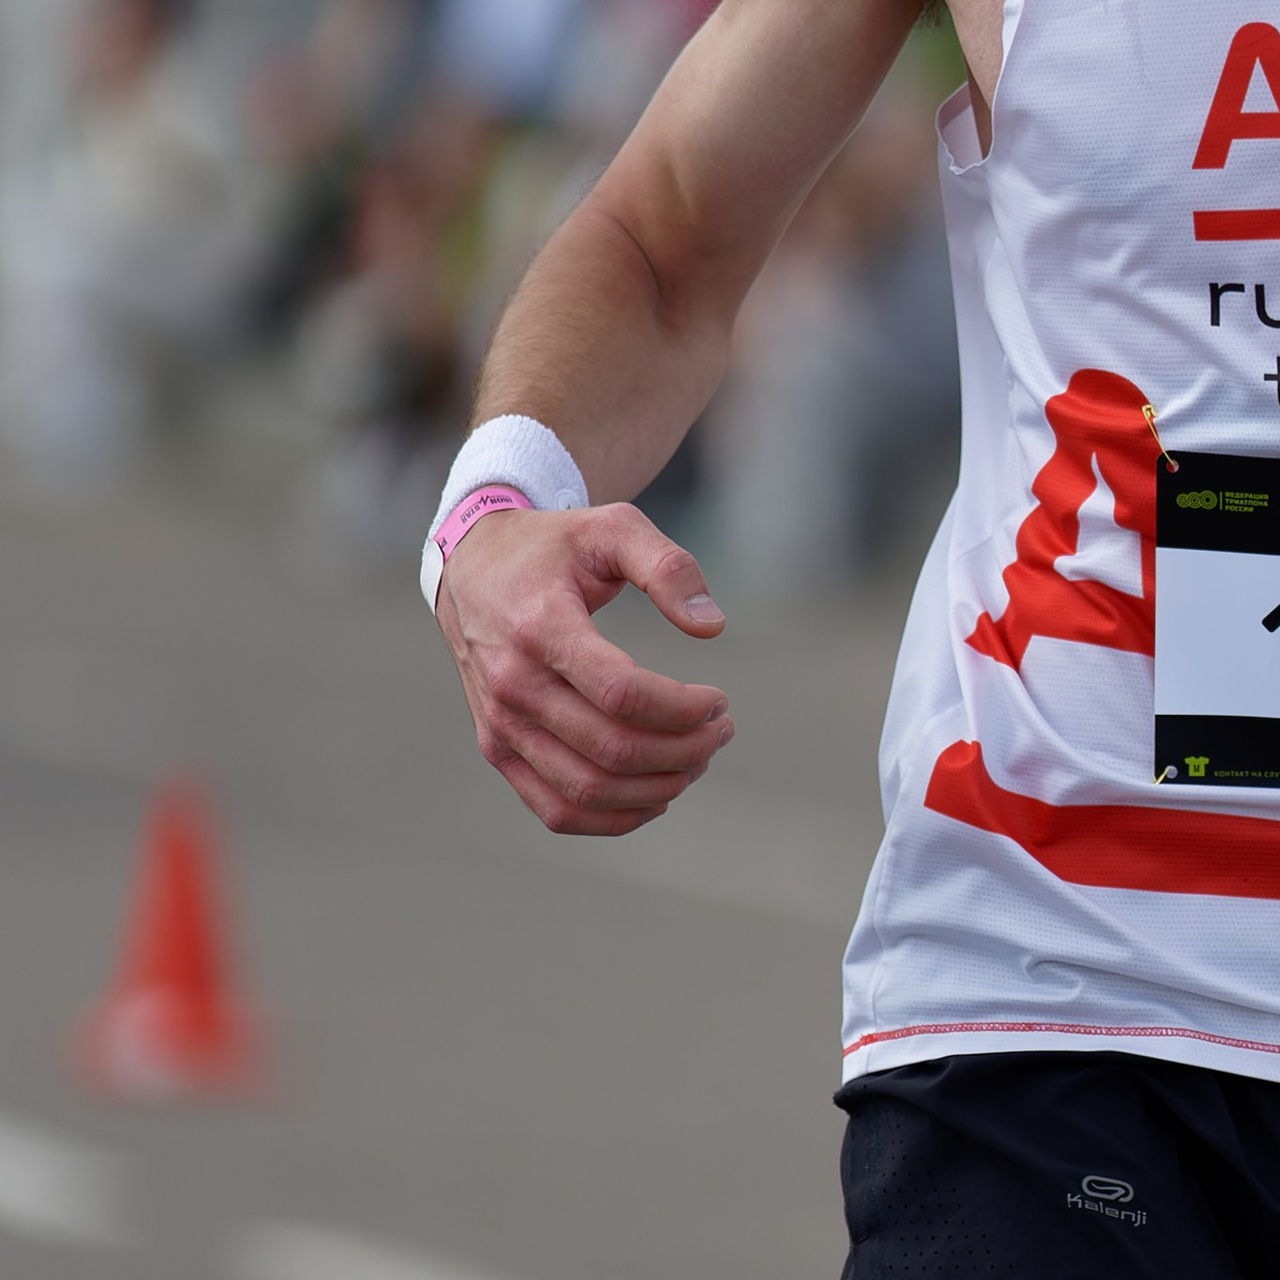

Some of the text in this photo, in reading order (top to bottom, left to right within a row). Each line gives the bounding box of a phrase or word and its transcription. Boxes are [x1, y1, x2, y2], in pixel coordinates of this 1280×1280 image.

[1224, 491, 1270, 500] ФЕДЕРАЦИЯ
[1224, 498, 1270, 507] ТРИАТЛОНА
[1224, 505, 1255, 513] РОССИИ
[1066, 1193, 1147, 1227] Kalenji
